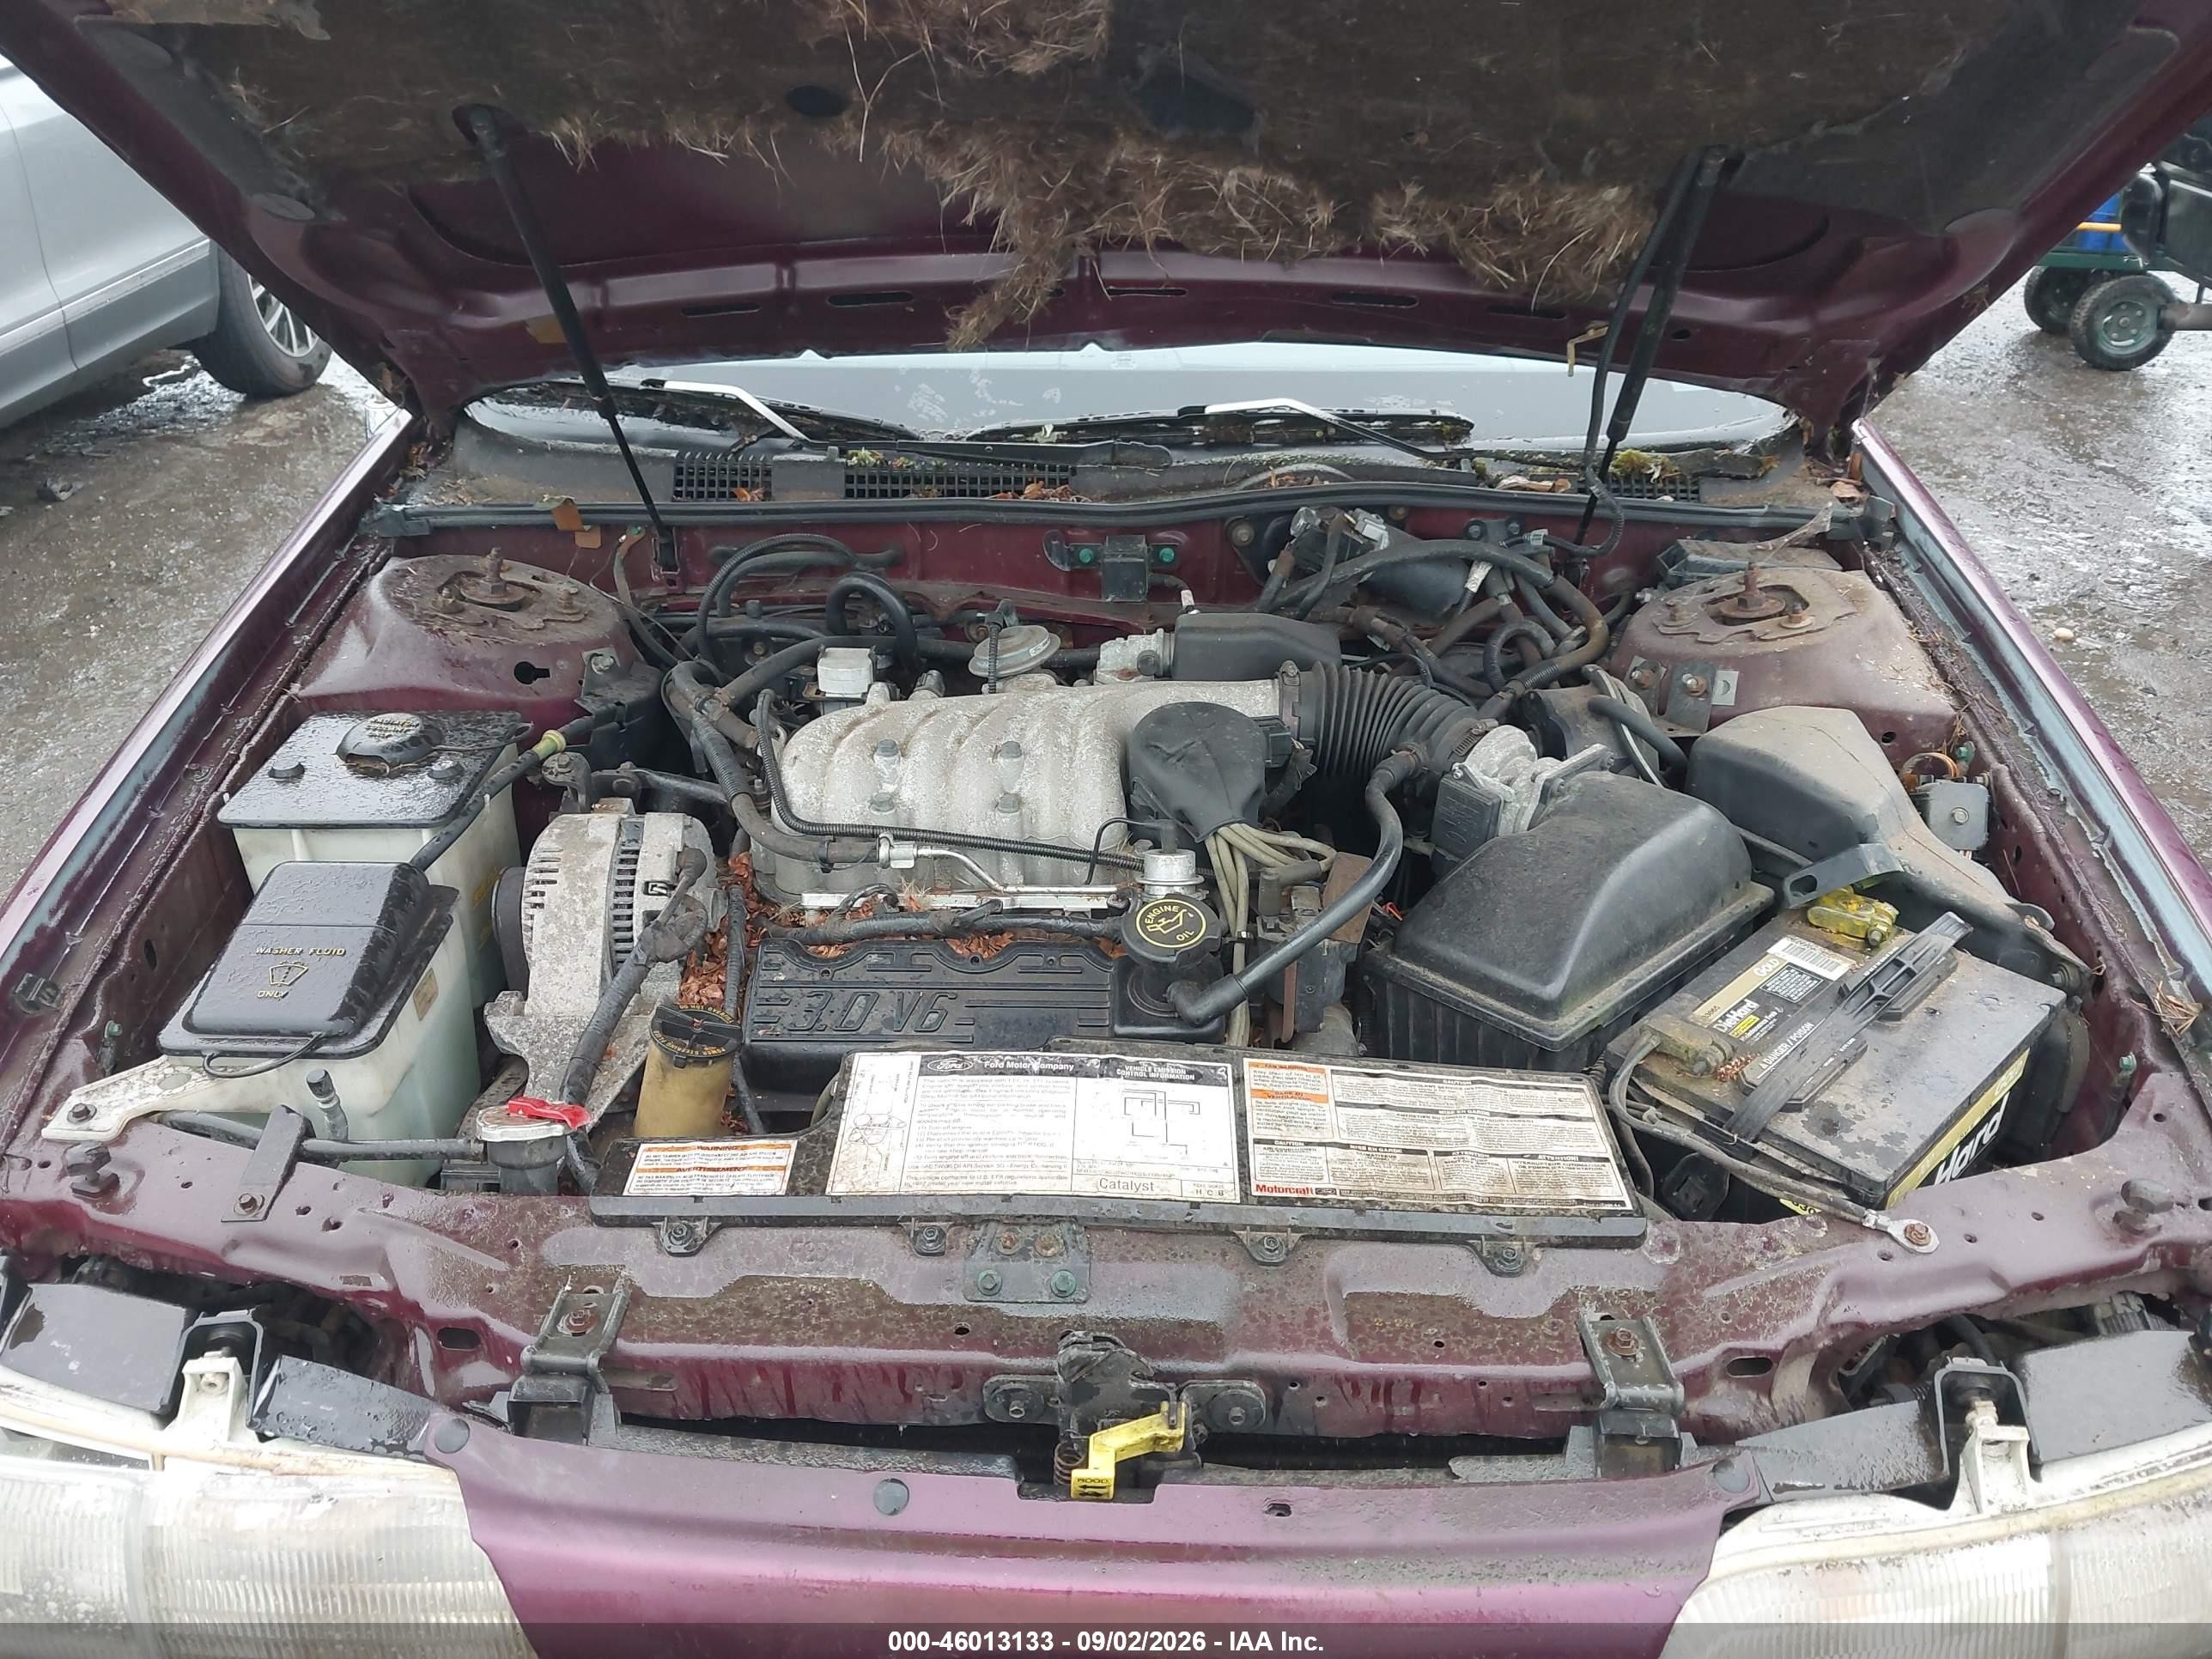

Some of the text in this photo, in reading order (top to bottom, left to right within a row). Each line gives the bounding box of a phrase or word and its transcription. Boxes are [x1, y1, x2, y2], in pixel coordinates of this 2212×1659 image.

[1145, 905, 1181, 924] ENGINE
[1176, 930, 1195, 941] OIL
[256, 947, 347, 957] WASHER FLUID
[1753, 957, 1780, 977] GOLD
[257, 990, 289, 1000] ONLY
[892, 991, 958, 1033] V6
[1712, 998, 1760, 1034] DieHard
[665, 1041, 700, 1055] STEERING
[1761, 1042, 1790, 1066] DANGER
[1791, 1021, 1815, 1042] POISON
[1006, 1061, 1031, 1070] Motor
[1125, 1065, 1187, 1075] VEHICLE EMISSION
[1116, 1068, 1195, 1081] CONTROL INFORMATION
[1098, 1177, 1155, 1194] Catalyst
[1255, 1183, 1314, 1195] Motorcraft
